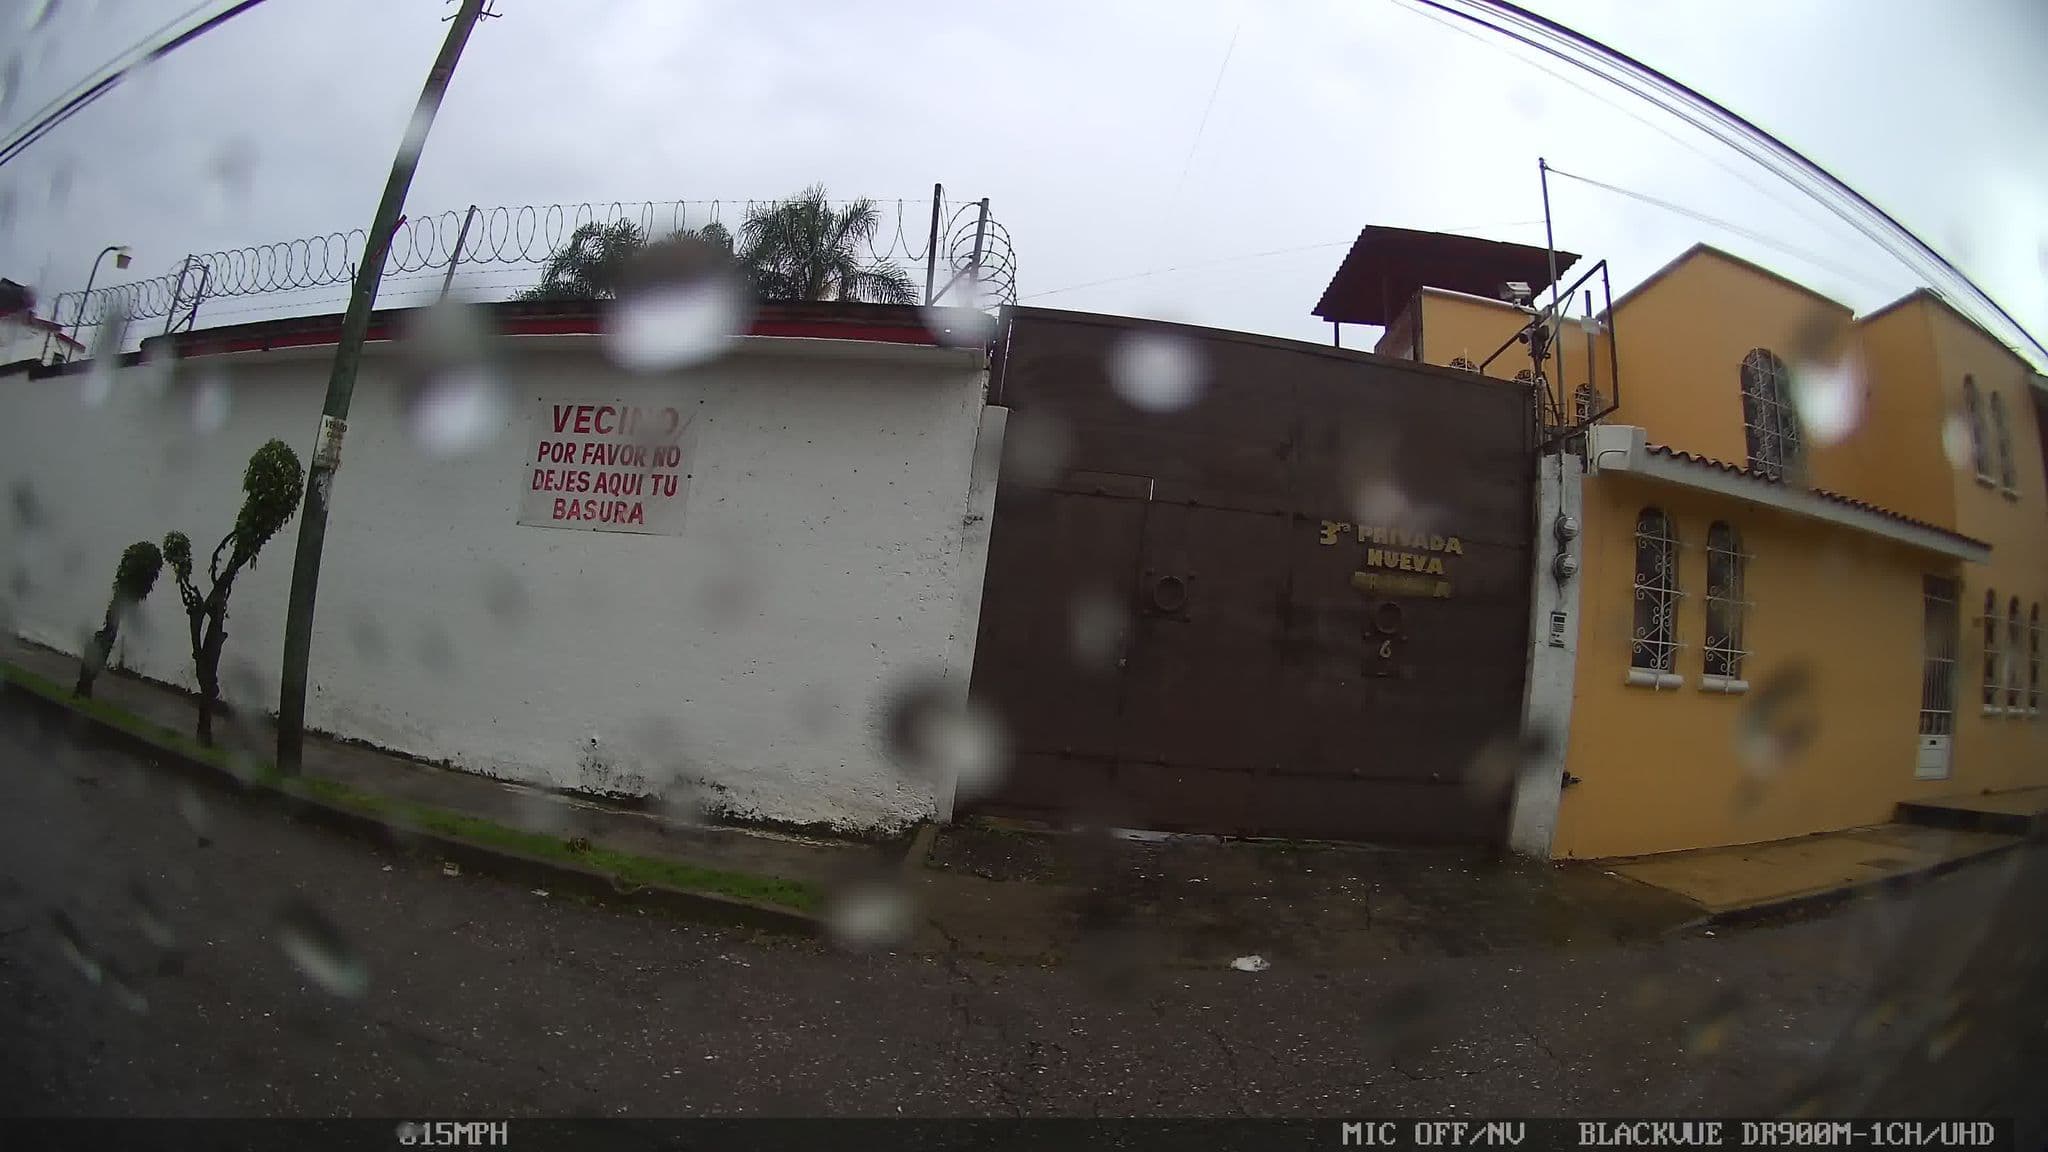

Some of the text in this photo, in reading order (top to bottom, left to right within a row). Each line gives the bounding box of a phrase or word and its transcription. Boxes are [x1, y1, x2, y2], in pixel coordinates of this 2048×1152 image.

[553, 405, 679, 434] VECIO
[538, 441, 681, 468] POR FAVOR NO
[532, 469, 678, 497] DEJES AQUI TU
[553, 498, 644, 525] BASURA
[1367, 548, 1444, 575] NUEVA
[1379, 640, 1392, 658] 6
